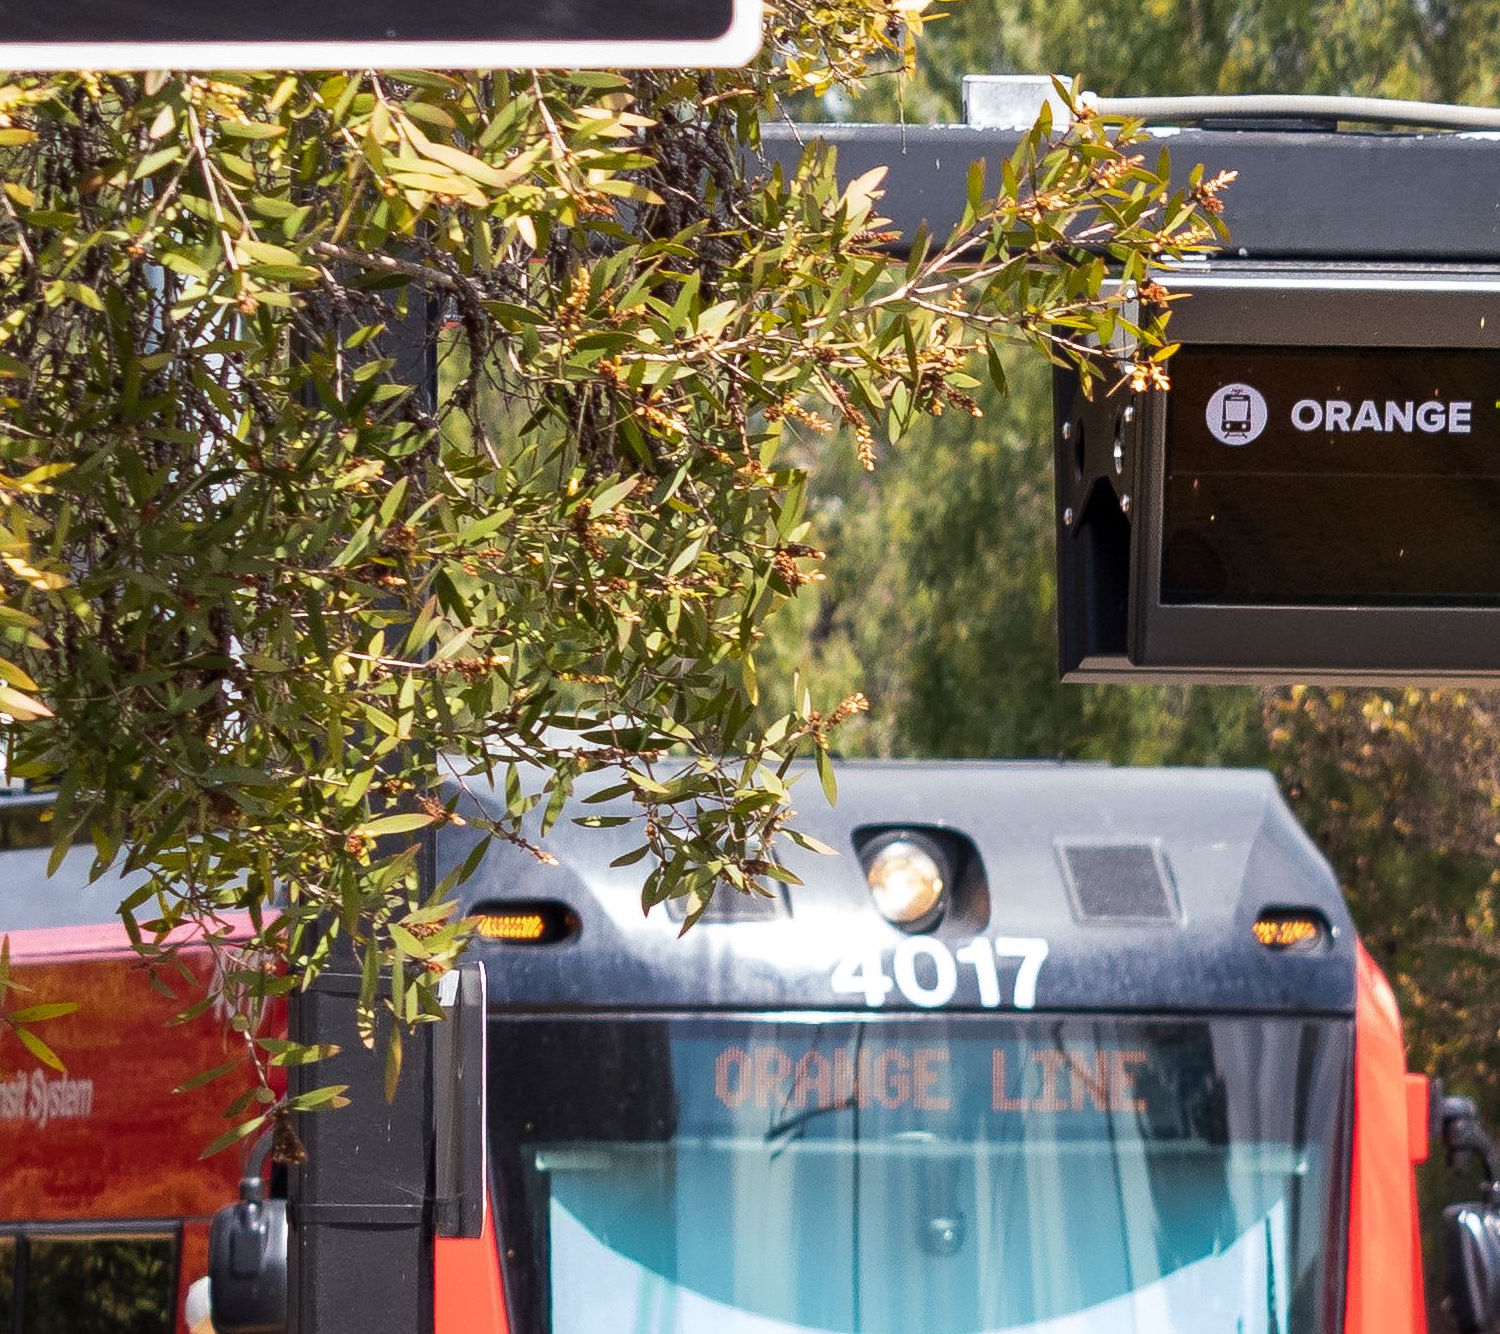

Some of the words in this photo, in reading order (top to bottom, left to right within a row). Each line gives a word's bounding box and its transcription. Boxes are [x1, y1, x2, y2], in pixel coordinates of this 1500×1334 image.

[1290, 399, 1472, 434] ORANGE
[831, 936, 1049, 1008] 4017
[714, 1045, 950, 1112] ORANGE
[992, 1049, 1148, 1113] LINE
